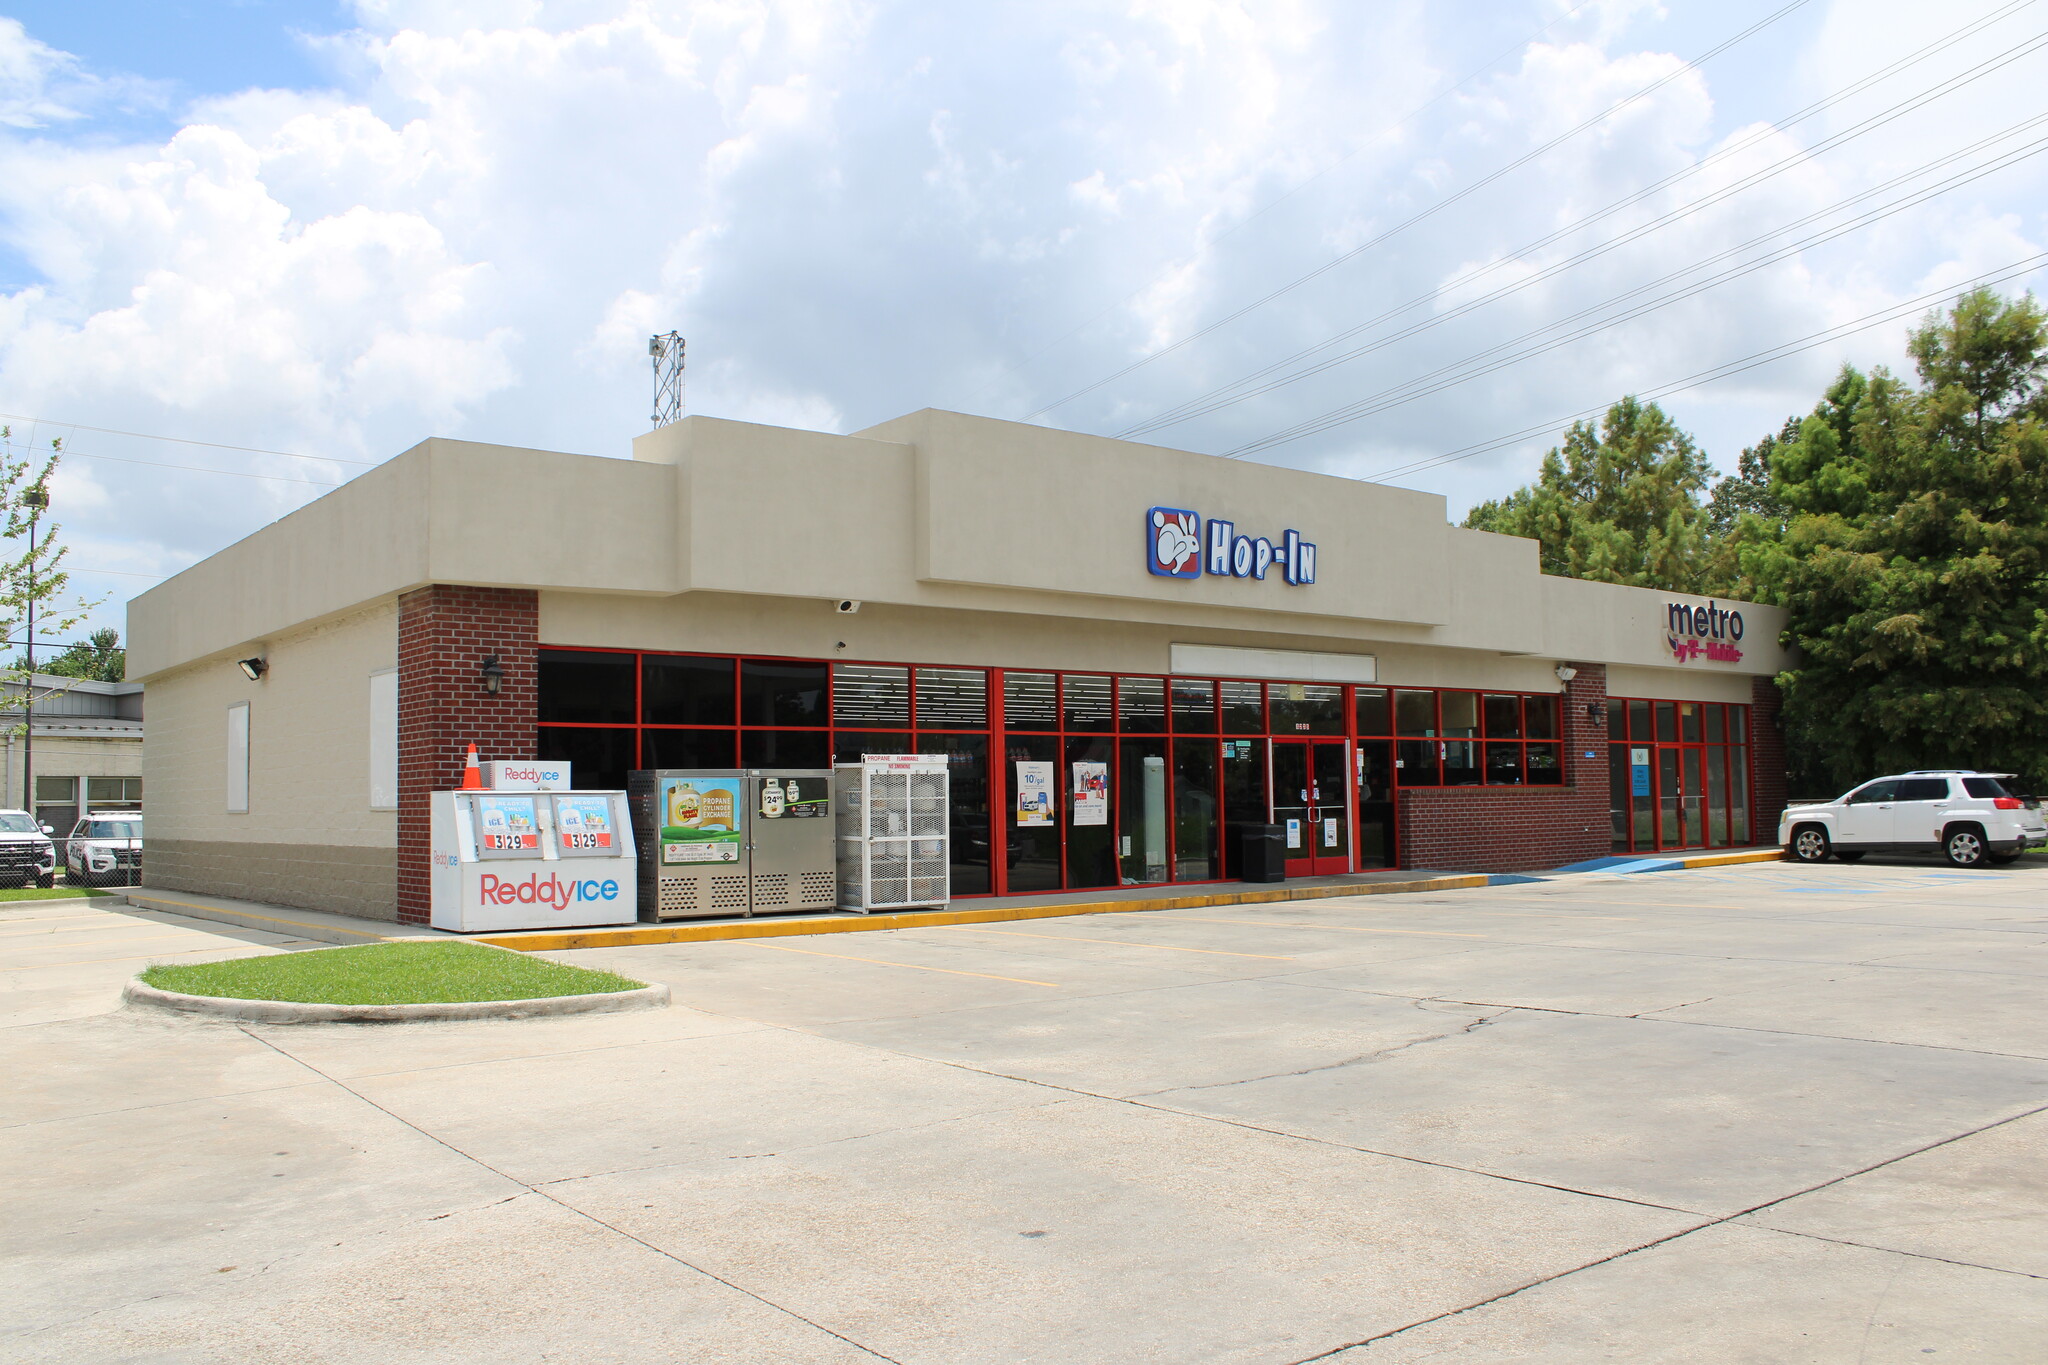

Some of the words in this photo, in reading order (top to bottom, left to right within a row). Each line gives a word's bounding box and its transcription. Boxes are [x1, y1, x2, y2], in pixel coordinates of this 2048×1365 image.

[1667, 600, 1744, 645] metro
[703, 797, 731, 805] PROPANE
[488, 818, 503, 826] ICE
[565, 817, 579, 825] ICE
